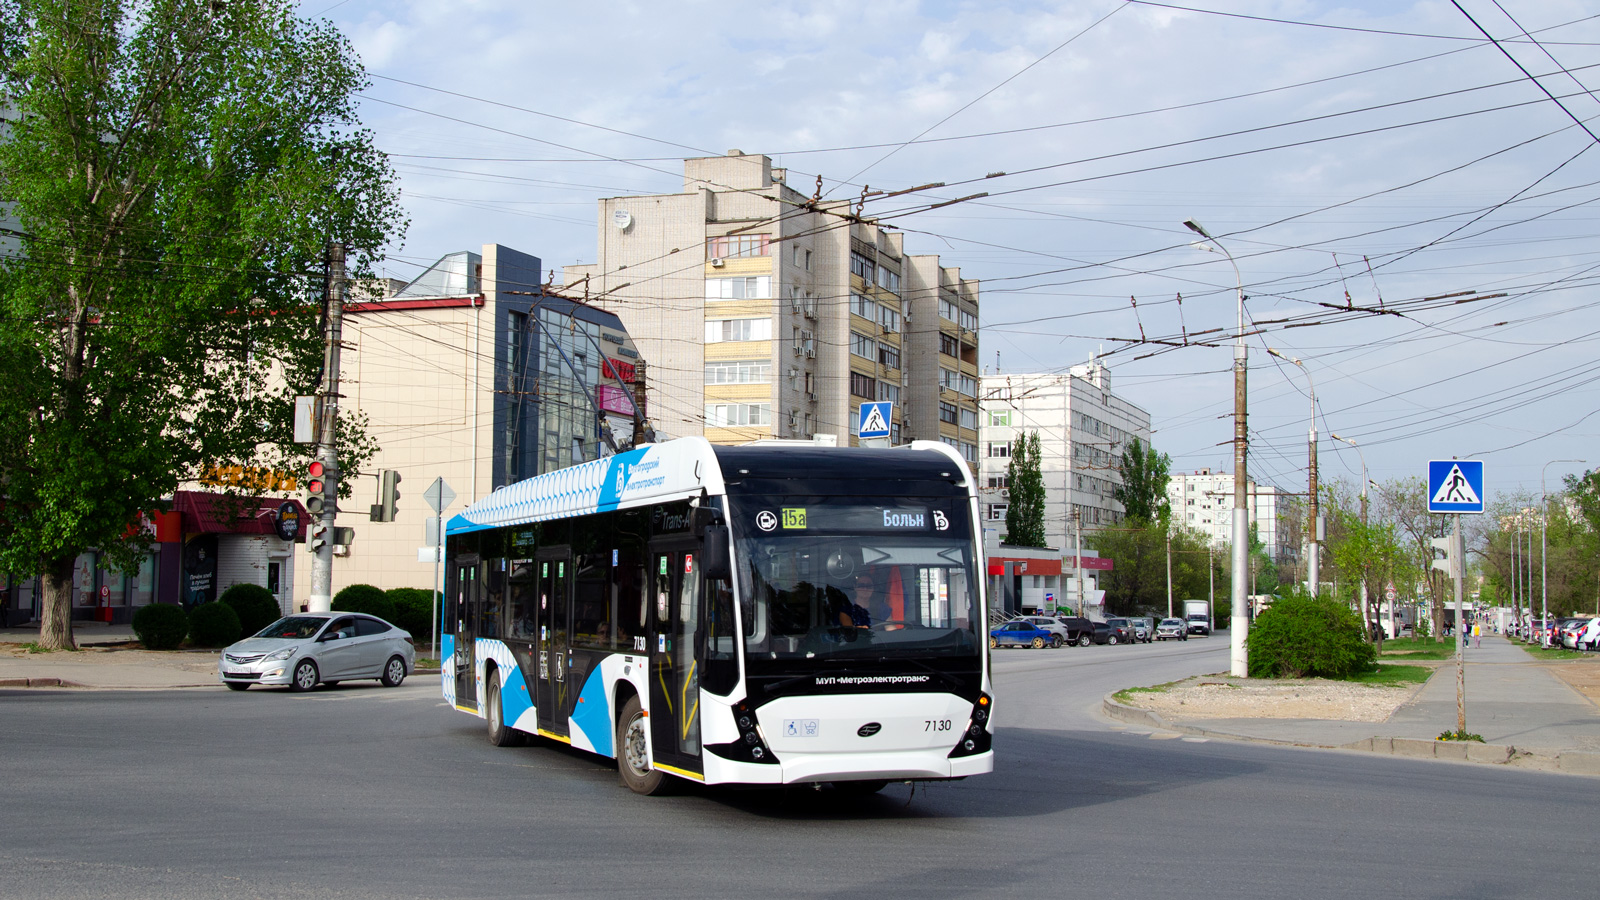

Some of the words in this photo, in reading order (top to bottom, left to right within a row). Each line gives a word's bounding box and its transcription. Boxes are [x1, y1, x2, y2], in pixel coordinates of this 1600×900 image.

[883, 509, 924, 527] Больн
[633, 635, 646, 651] 7130
[815, 677, 836, 685] МУП
[837, 675, 929, 685] «Метроэлектротранс»
[924, 719, 952, 732] 7130
